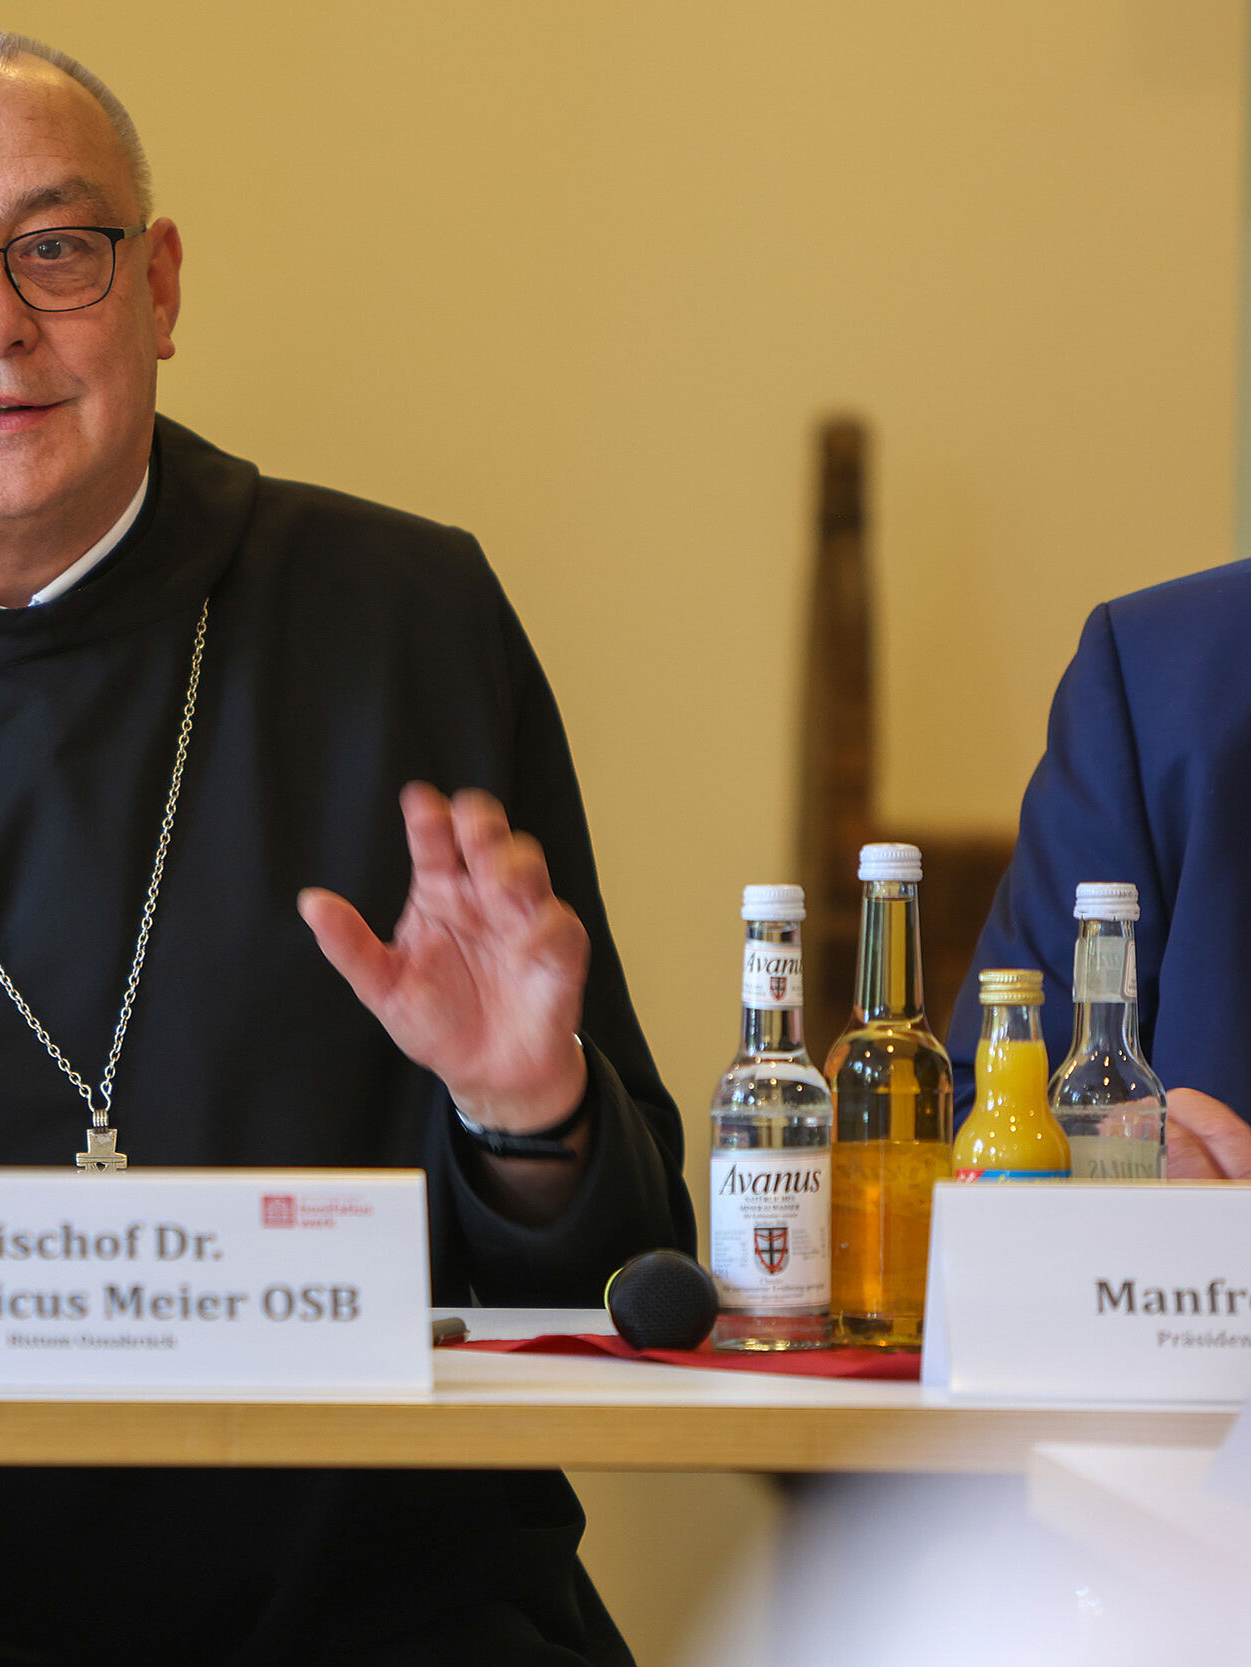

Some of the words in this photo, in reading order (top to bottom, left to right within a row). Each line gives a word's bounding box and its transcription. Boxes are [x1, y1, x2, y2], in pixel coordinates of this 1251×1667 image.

[719, 1163, 822, 1195] Avanus
[153, 1223, 223, 1261] Dr.
[104, 1283, 248, 1321] Meier
[262, 1284, 361, 1322] OSB
[1095, 1278, 1251, 1315] Manfr
